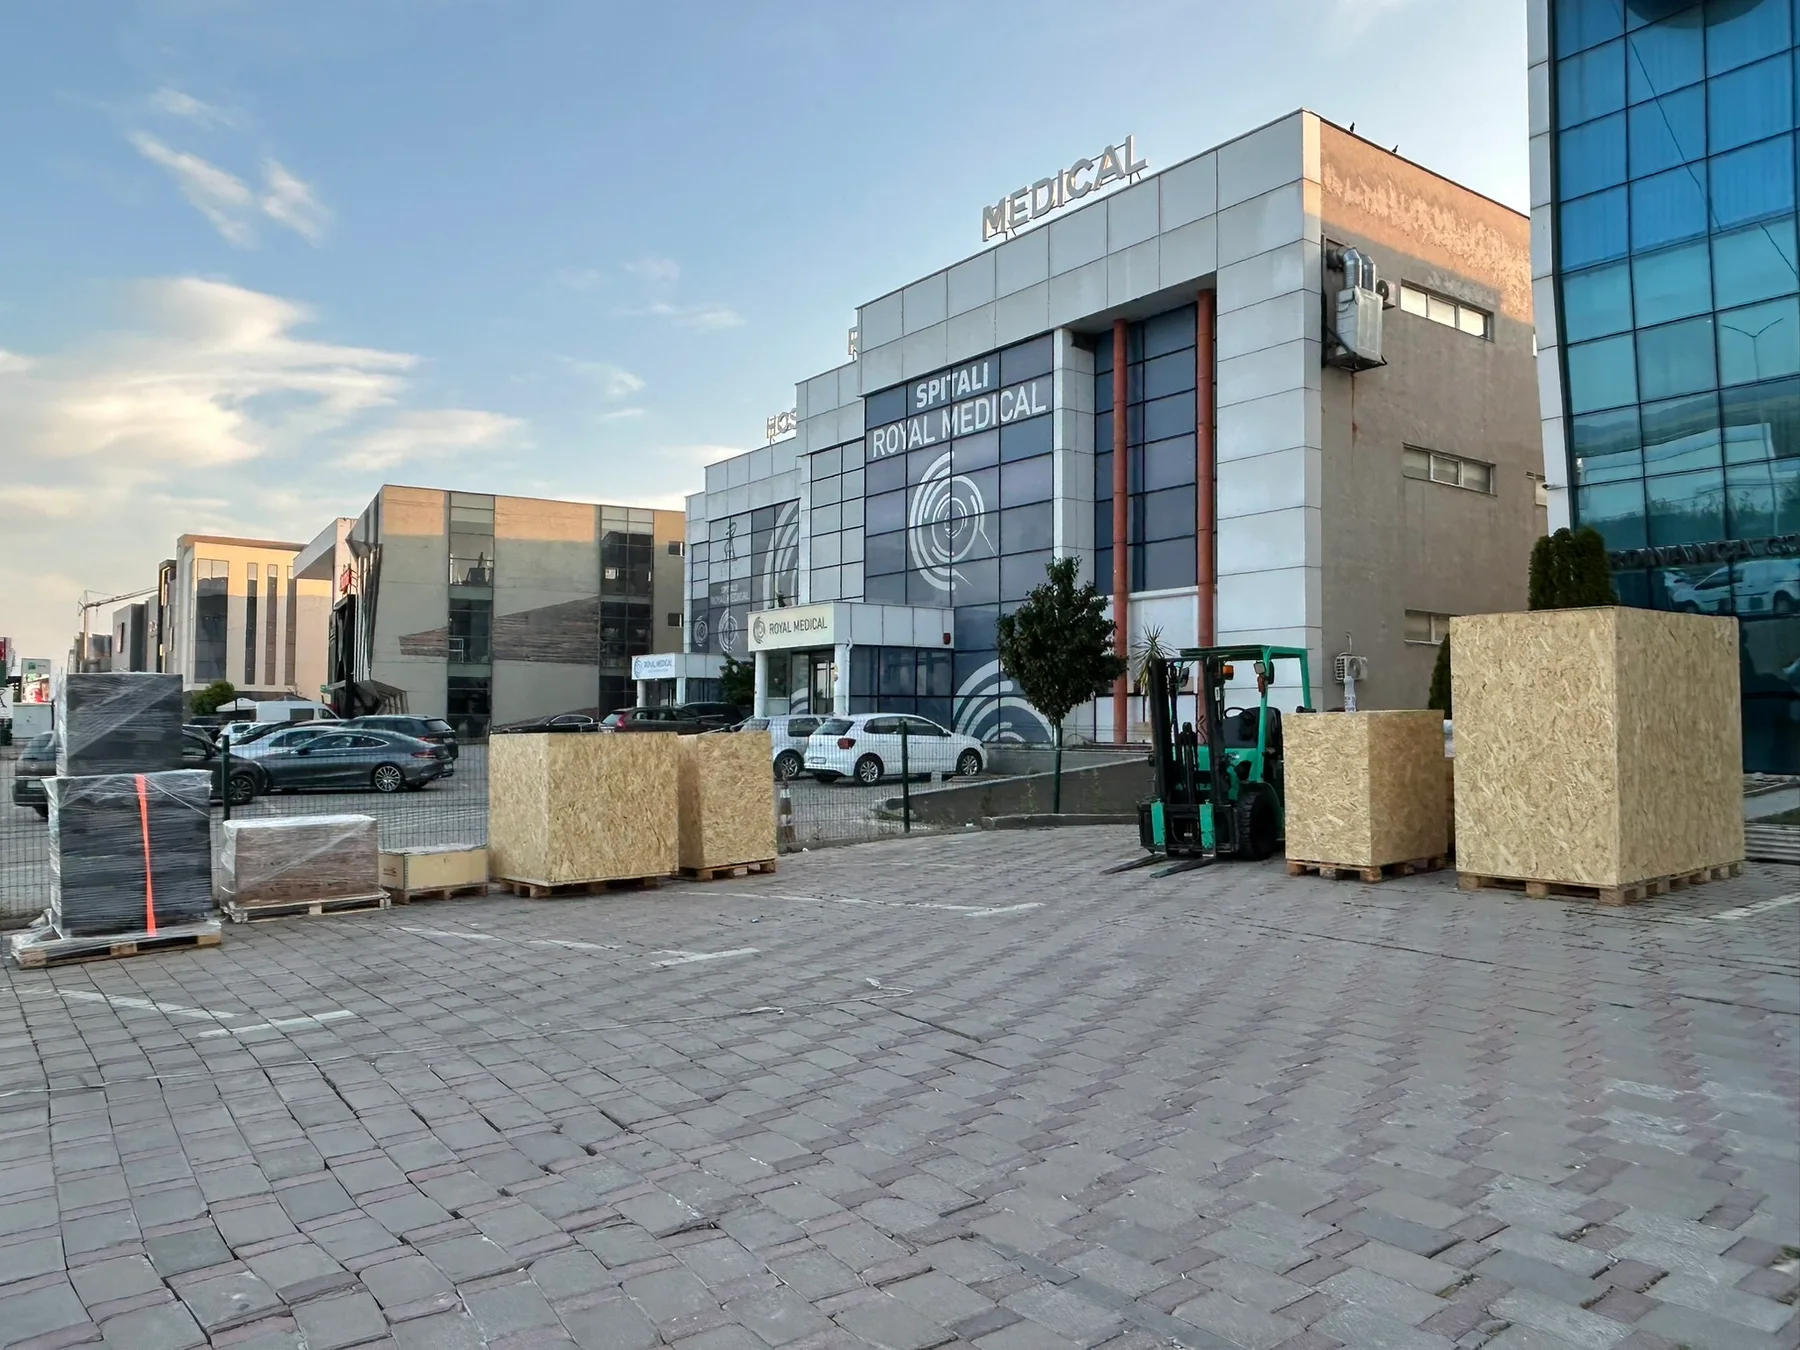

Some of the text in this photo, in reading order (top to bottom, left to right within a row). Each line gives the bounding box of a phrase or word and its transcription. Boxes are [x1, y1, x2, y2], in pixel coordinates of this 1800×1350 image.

[982, 135, 1148, 242] MEDICAL
[916, 362, 989, 408] SPITALI
[873, 382, 1047, 458] ROYAL MEDICAL
[769, 616, 828, 635] ROYAL MEDICAL
